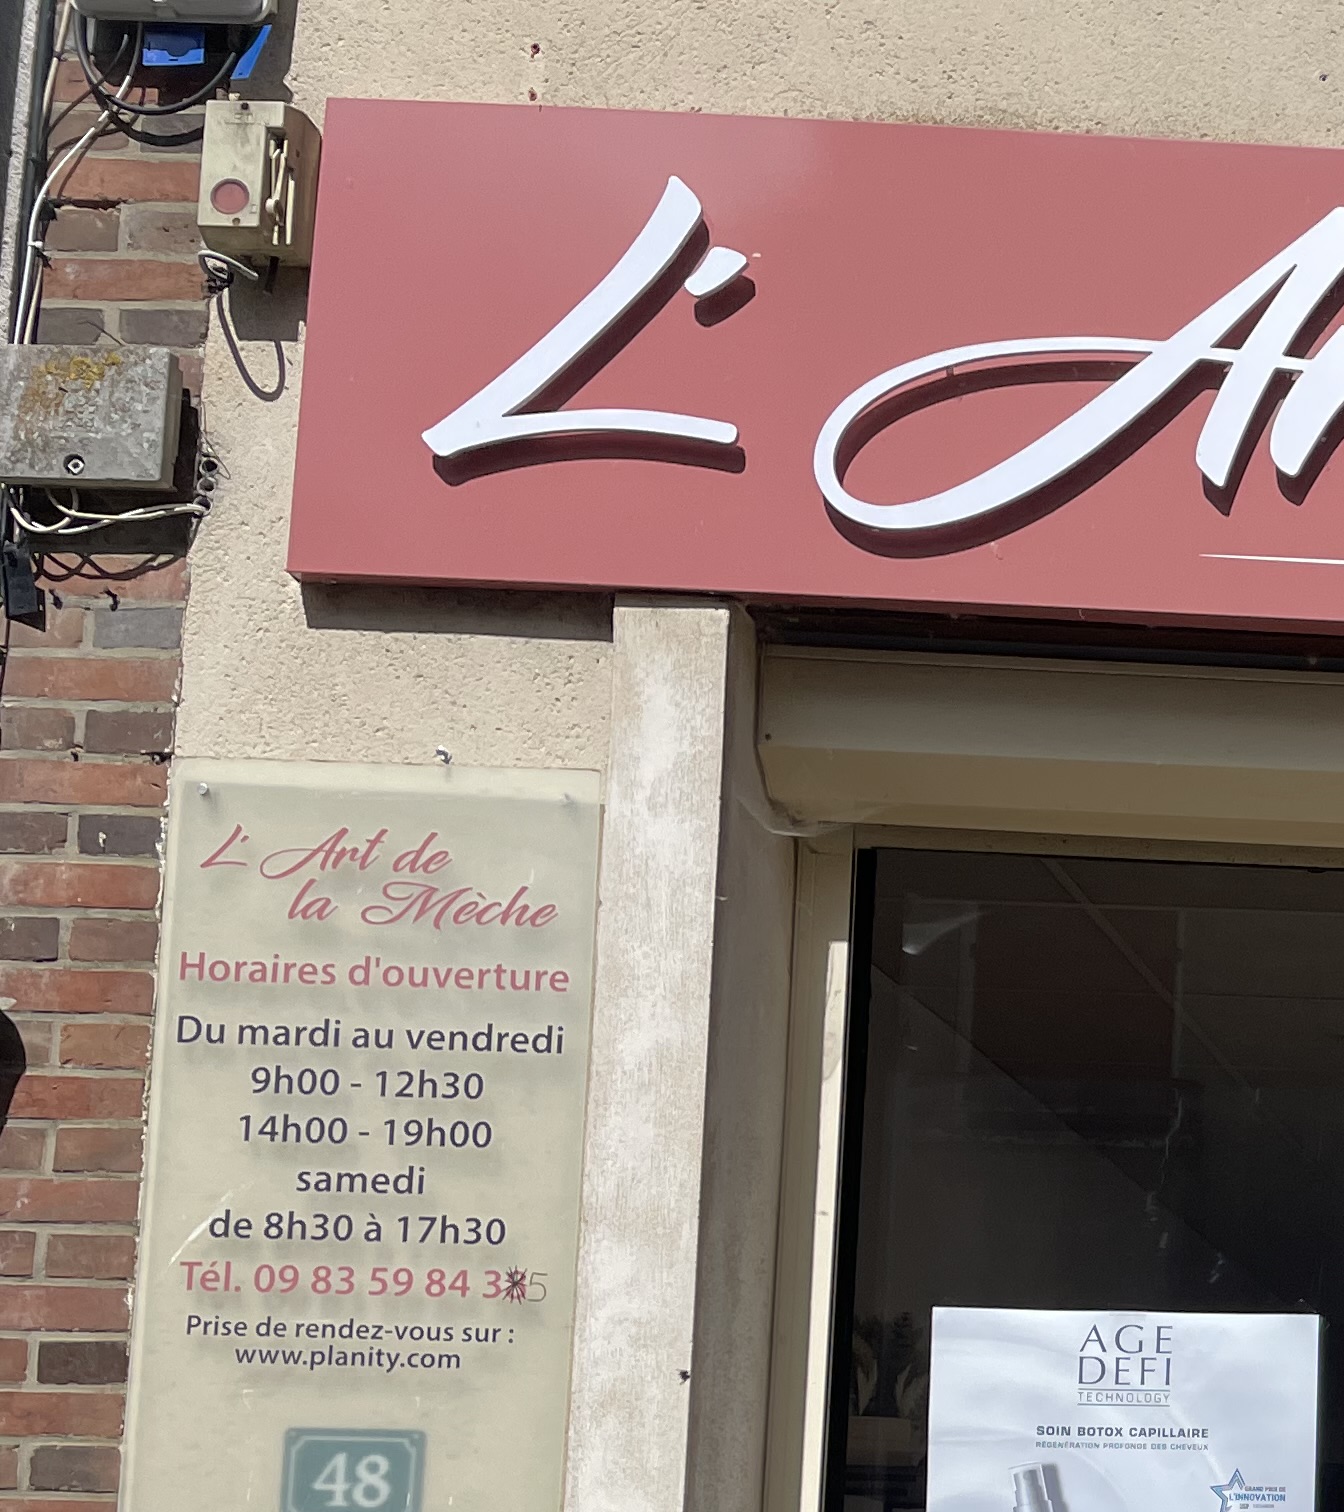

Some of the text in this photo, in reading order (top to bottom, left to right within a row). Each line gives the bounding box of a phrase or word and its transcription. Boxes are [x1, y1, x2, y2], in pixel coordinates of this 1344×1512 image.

[421, 175, 747, 457] L'
[259, 827, 389, 879] Art
[392, 832, 453, 875] de
[287, 878, 559, 930] la Mèche
[179, 952, 570, 993] Horaires d'ouverture
[176, 1015, 565, 1055] Du mardi au vendredi
[250, 1065, 341, 1096] 9h00
[375, 1069, 485, 1101] 12h30
[239, 1114, 348, 1145] 14h00
[384, 1118, 493, 1149] 19h00
[296, 1166, 426, 1195] samedi
[208, 1210, 507, 1246] de 8h30 à 17h30
[180, 1261, 242, 1293] Tél.
[254, 1264, 300, 1294] 09
[311, 1266, 355, 1295] 83
[368, 1268, 414, 1297] 59
[425, 1268, 470, 1299] 84
[186, 1315, 248, 1338] Prise
[256, 1316, 287, 1338] de
[295, 1319, 454, 1342] rendez-vous
[462, 1325, 501, 1343] sur
[1080, 1324, 1173, 1354] AGE
[235, 1345, 461, 1374] www.planity.com
[1078, 1356, 1171, 1386] DEFI
[1077, 1391, 1171, 1404] TECHNOLOGY
[1036, 1425, 1209, 1439] SOIN BOTOX CAPILLAIRE
[1170, 1443, 1209, 1451] CHEVEUX
[312, 1452, 391, 1508] 48
